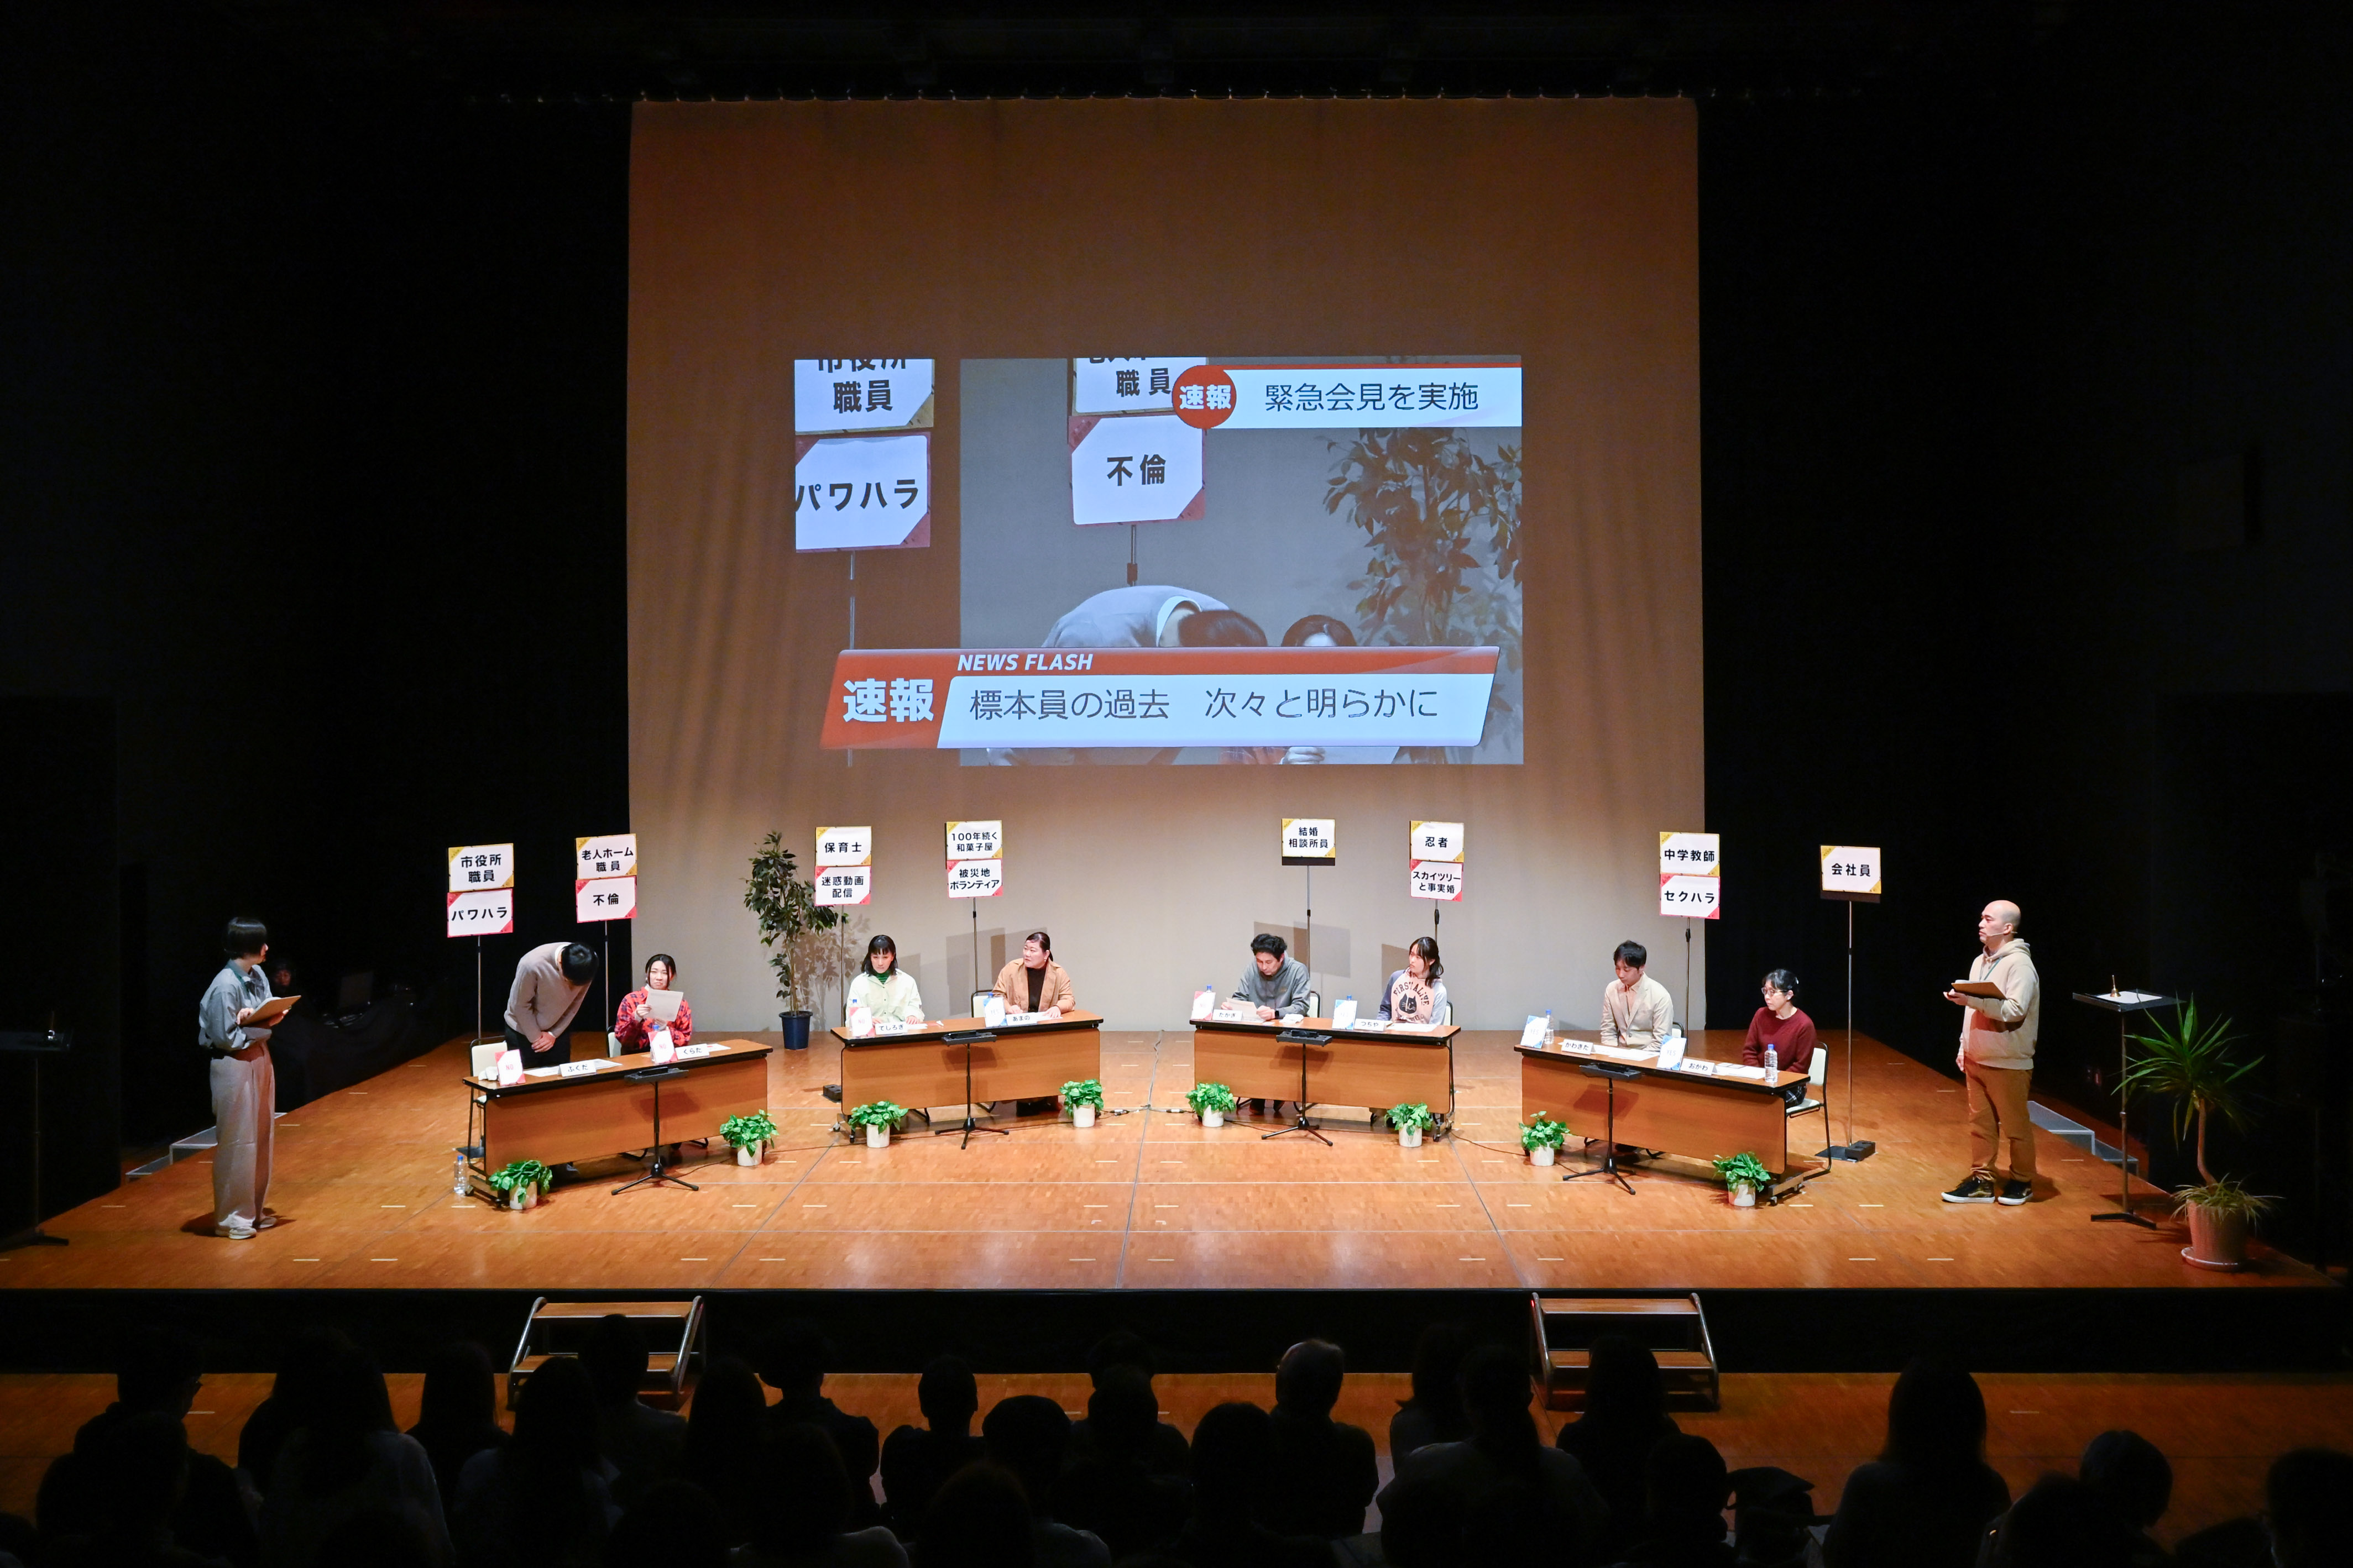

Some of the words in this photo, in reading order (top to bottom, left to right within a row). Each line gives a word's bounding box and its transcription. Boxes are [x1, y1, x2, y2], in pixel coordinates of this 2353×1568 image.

[1116, 368, 1172, 397] 職員
[834, 380, 892, 413] 職員
[1179, 384, 1232, 410] 速報
[1266, 382, 1478, 411] 緊急会見を実施
[1107, 454, 1165, 486] 不倫
[795, 479, 918, 512] パワハラ
[956, 654, 1019, 671] NEWS
[1024, 653, 1093, 670] FLASH
[843, 678, 934, 722] 速報
[970, 689, 1169, 720] 標本員の過去
[1206, 688, 1437, 718] 次々と明らかに
[952, 832, 997, 841] 100年続く
[1299, 827, 1317, 836] 結婚
[825, 842, 861, 853] 保育士
[957, 843, 992, 852] 和菓子屋
[1289, 838, 1327, 848] 相談所員
[1425, 837, 1447, 848] 忍者
[582, 847, 634, 861] 老人ホーム
[1665, 849, 1714, 862] 中学教師
[461, 854, 501, 868] 市役所
[596, 861, 620, 872] 職員
[468, 870, 494, 883] 職員
[959, 868, 990, 878] 被災地
[1413, 871, 1461, 882] スカイツリー
[1832, 863, 1870, 877] 会社員
[822, 876, 864, 885] 迷惑動画
[950, 880, 999, 890] ボランティア
[833, 889, 852, 898] 配信
[1419, 883, 1455, 894] と事実婚
[593, 893, 619, 906] 不倫
[1665, 891, 1714, 904] セクハラ
[452, 907, 507, 921] パワハラ
[1565, 1042, 1589, 1051] かわきた
[567, 1064, 589, 1073] ふくだ
[1688, 1063, 1708, 1071] おかわ
